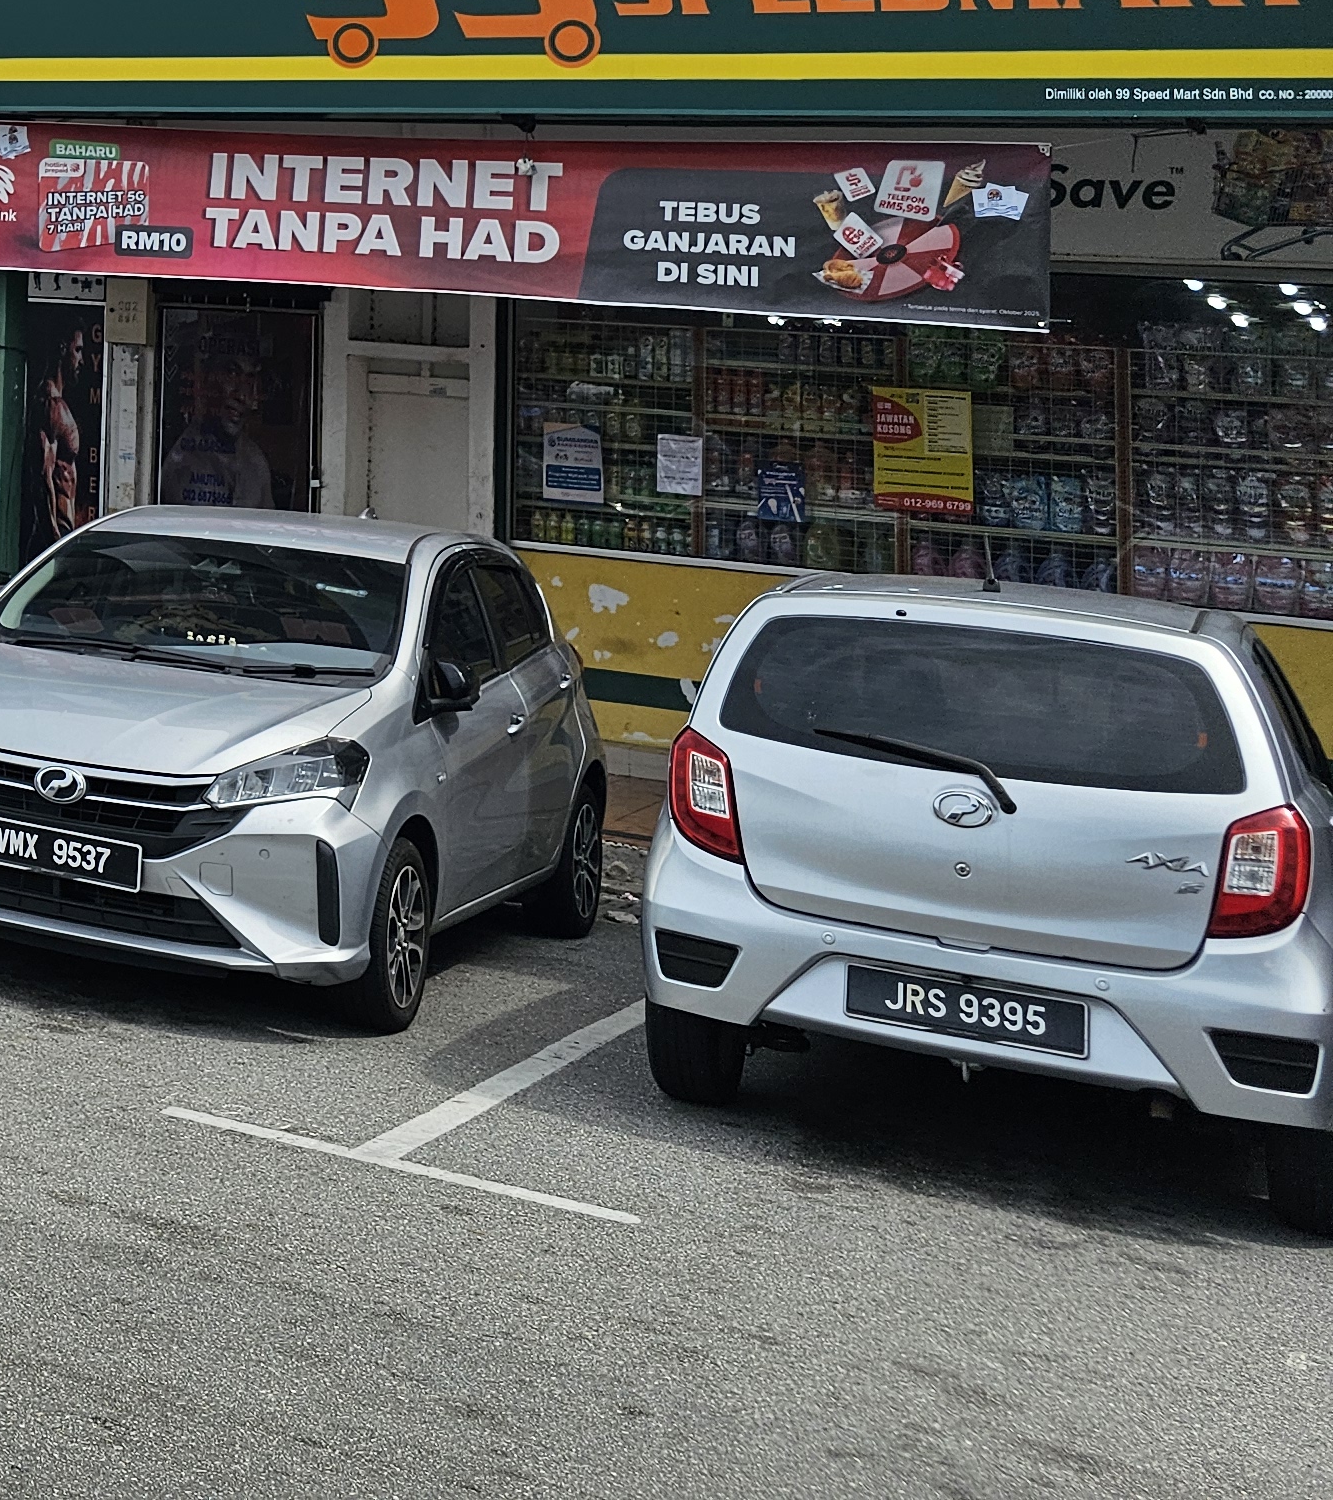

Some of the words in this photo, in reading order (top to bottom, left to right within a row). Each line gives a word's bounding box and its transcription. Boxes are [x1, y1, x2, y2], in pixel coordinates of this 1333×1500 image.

[1045, 88, 1085, 100] Dimiliki
[1088, 88, 1112, 100] oleh
[1115, 88, 1130, 100] 99
[1133, 88, 1170, 102] Speed
[1173, 88, 1200, 100] Mart
[1203, 88, 1226, 100] Sdn
[1229, 88, 1253, 100] Bhd
[55, 143, 116, 159] BAHARU
[208, 152, 564, 211] INTERNET
[1050, 163, 1176, 211] Save
[46, 190, 124, 206] INTERNET
[126, 190, 145, 203] 5G
[878, 200, 930, 215] RM5,999
[887, 193, 926, 204] TELEFON
[46, 205, 108, 222] TANPA
[112, 203, 145, 219] HAD
[659, 199, 761, 225] TEBUS
[47, 225, 55, 235] 7
[57, 222, 85, 233] HARI
[205, 207, 401, 257] TANPA
[418, 217, 561, 265] HAD
[121, 230, 187, 253] RM10
[623, 228, 796, 260] GANJARAN
[657, 261, 689, 284] DI
[696, 263, 760, 289] SINI
[876, 413, 914, 424] JAWATAN
[876, 424, 912, 435] KOSONG
[903, 497, 944, 509] 012-969
[946, 501, 972, 511] 6799
[52, 835, 112, 875] 9537
[884, 979, 948, 1018] JRS
[959, 996, 1047, 1037] 9395
